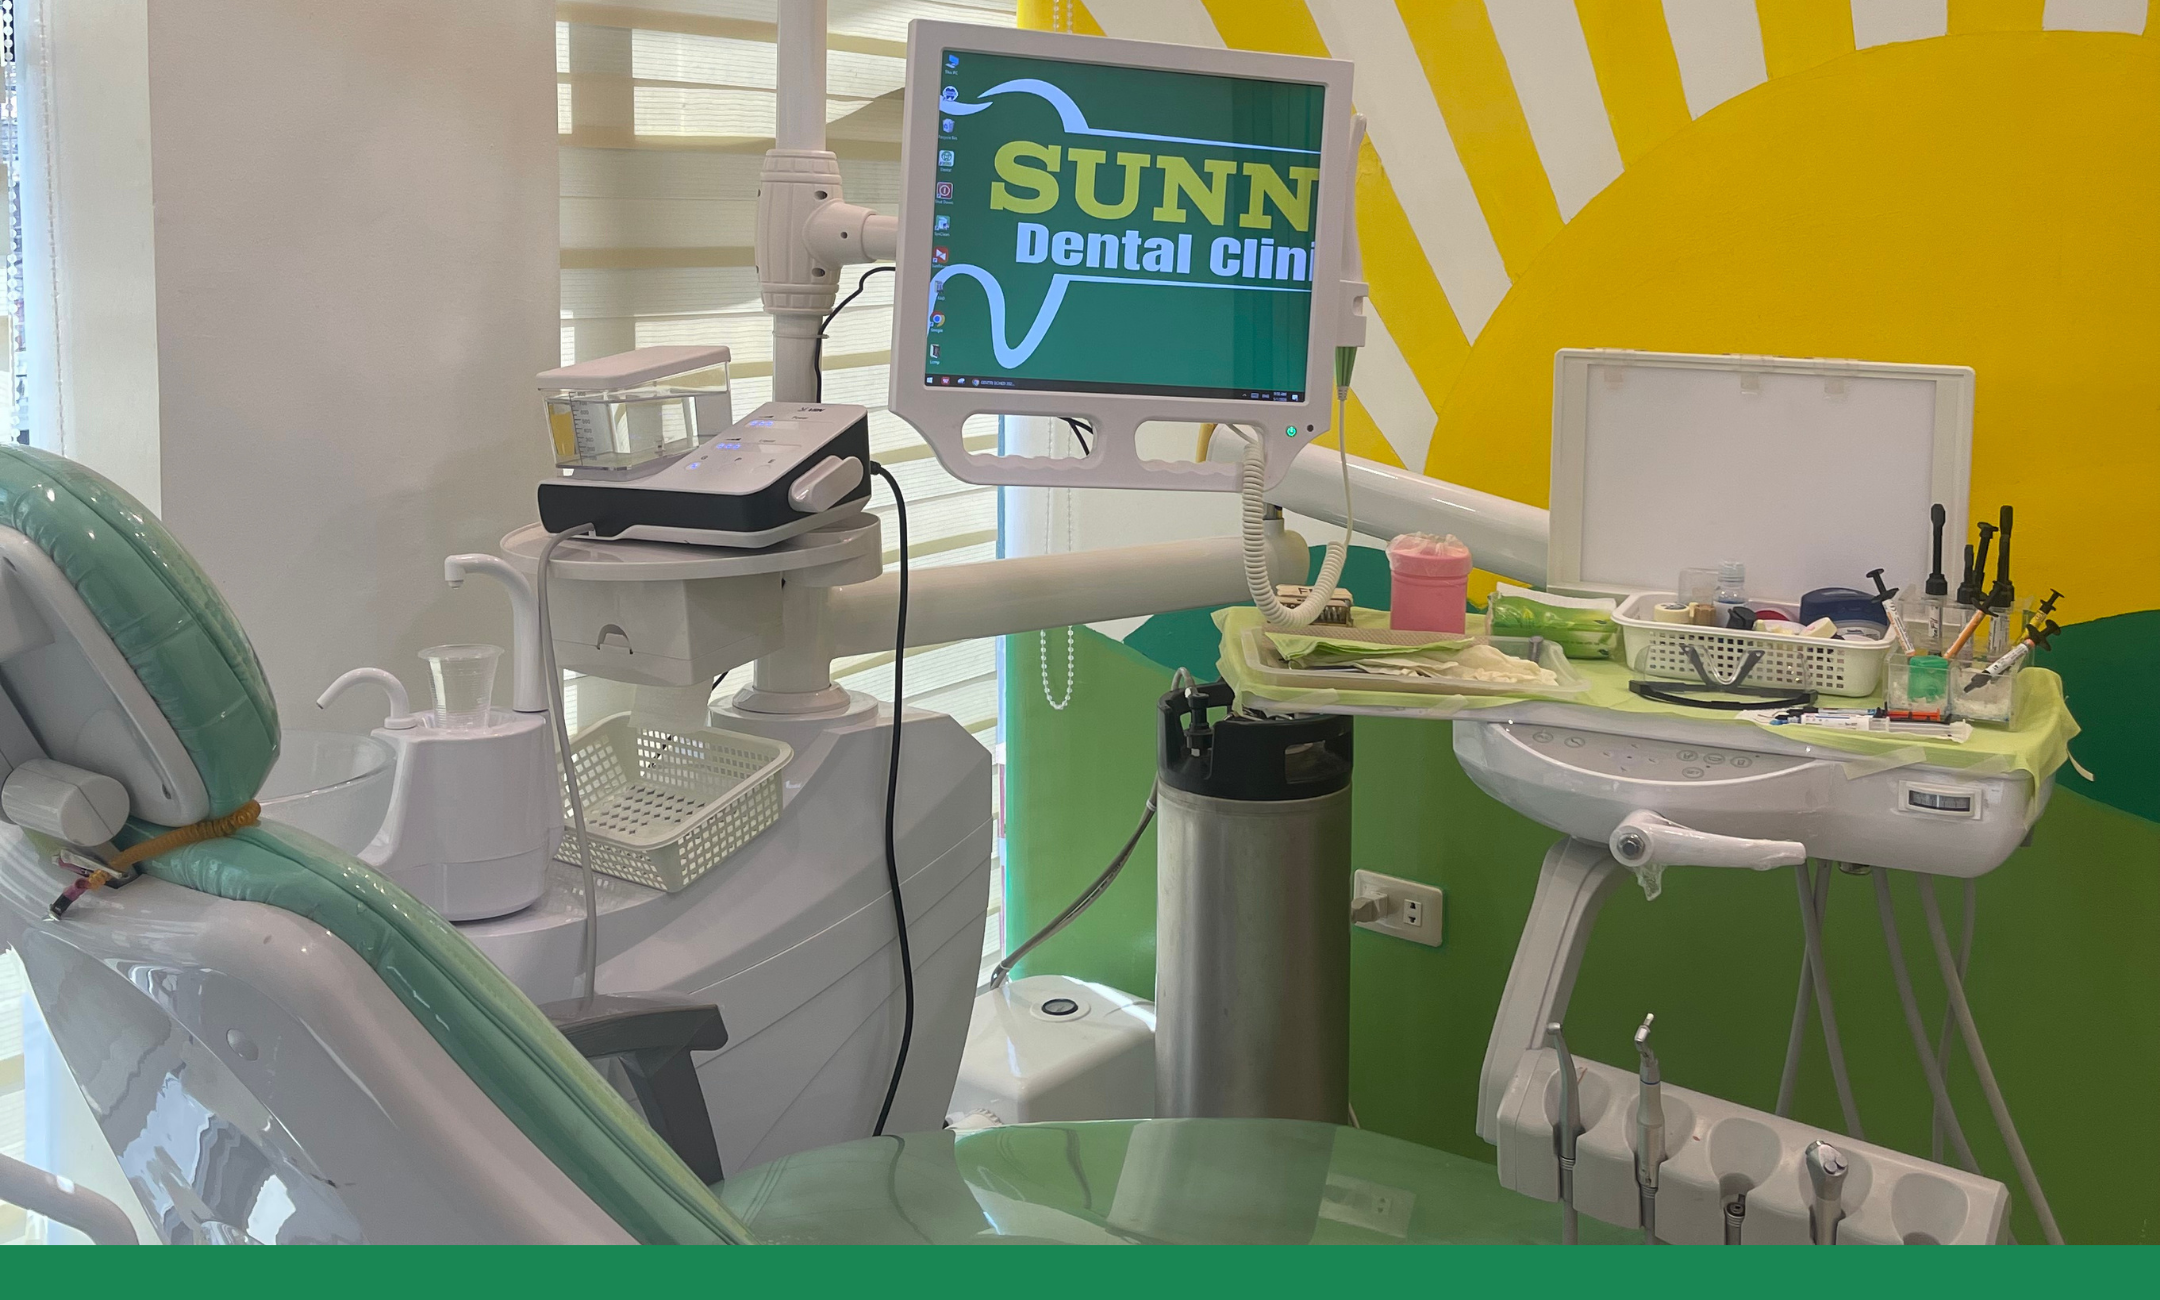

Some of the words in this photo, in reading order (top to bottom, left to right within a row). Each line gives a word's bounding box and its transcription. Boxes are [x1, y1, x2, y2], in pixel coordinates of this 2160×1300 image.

[989, 140, 1320, 232] SUNN
[1015, 222, 1193, 274] Dental
[1209, 236, 1316, 281] Clin
